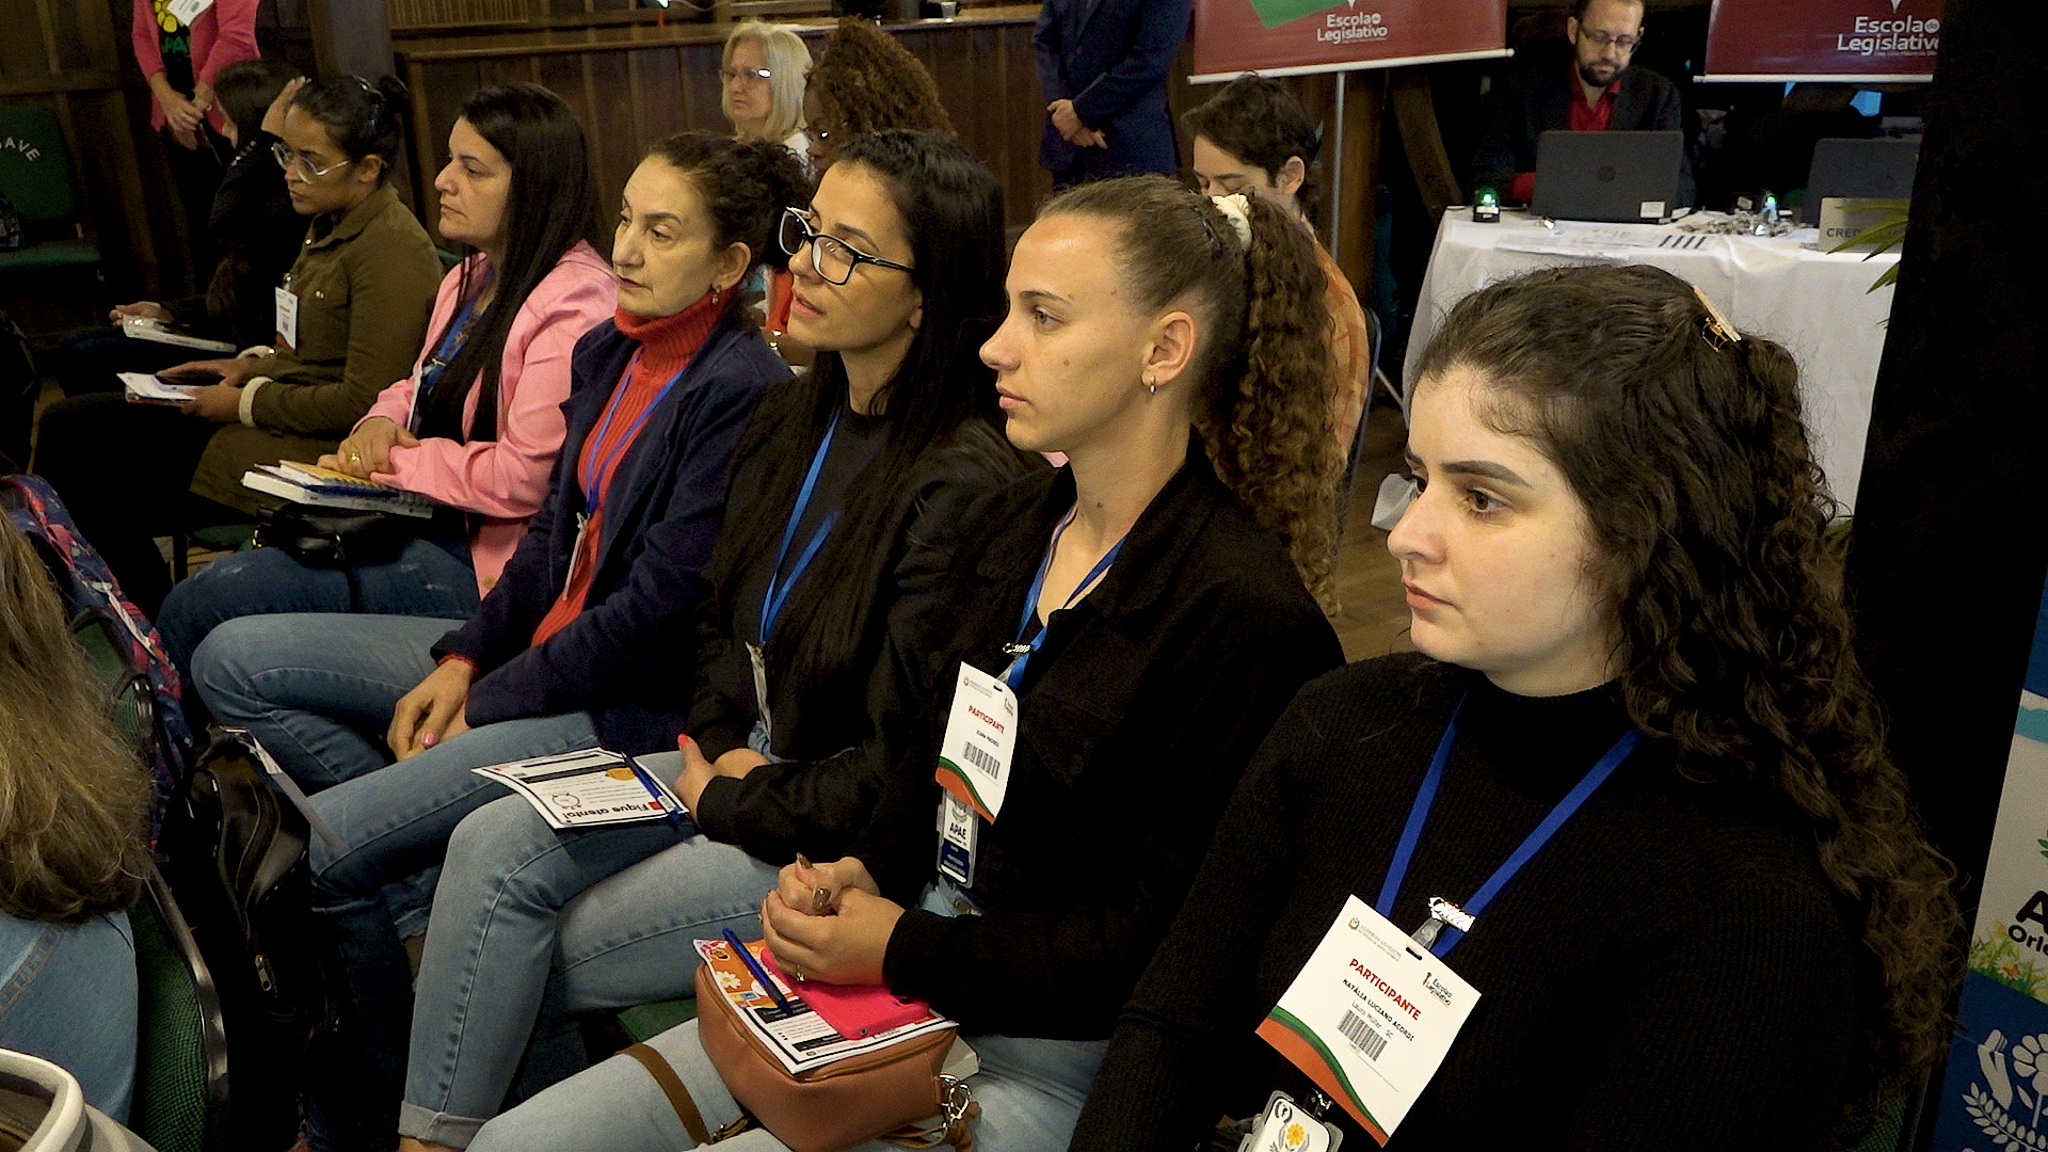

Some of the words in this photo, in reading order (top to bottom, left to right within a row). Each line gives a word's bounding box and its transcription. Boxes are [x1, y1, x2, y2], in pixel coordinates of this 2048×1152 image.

[1326, 11, 1371, 28] Escola
[1854, 14, 1924, 33] Escola
[1316, 24, 1388, 45] Legislativo
[0, 137, 41, 161] AVE
[968, 704, 1005, 735] PARTICIPANTE
[612, 802, 649, 814] Fique
[1349, 957, 1422, 1021] PARTICIPANTE
